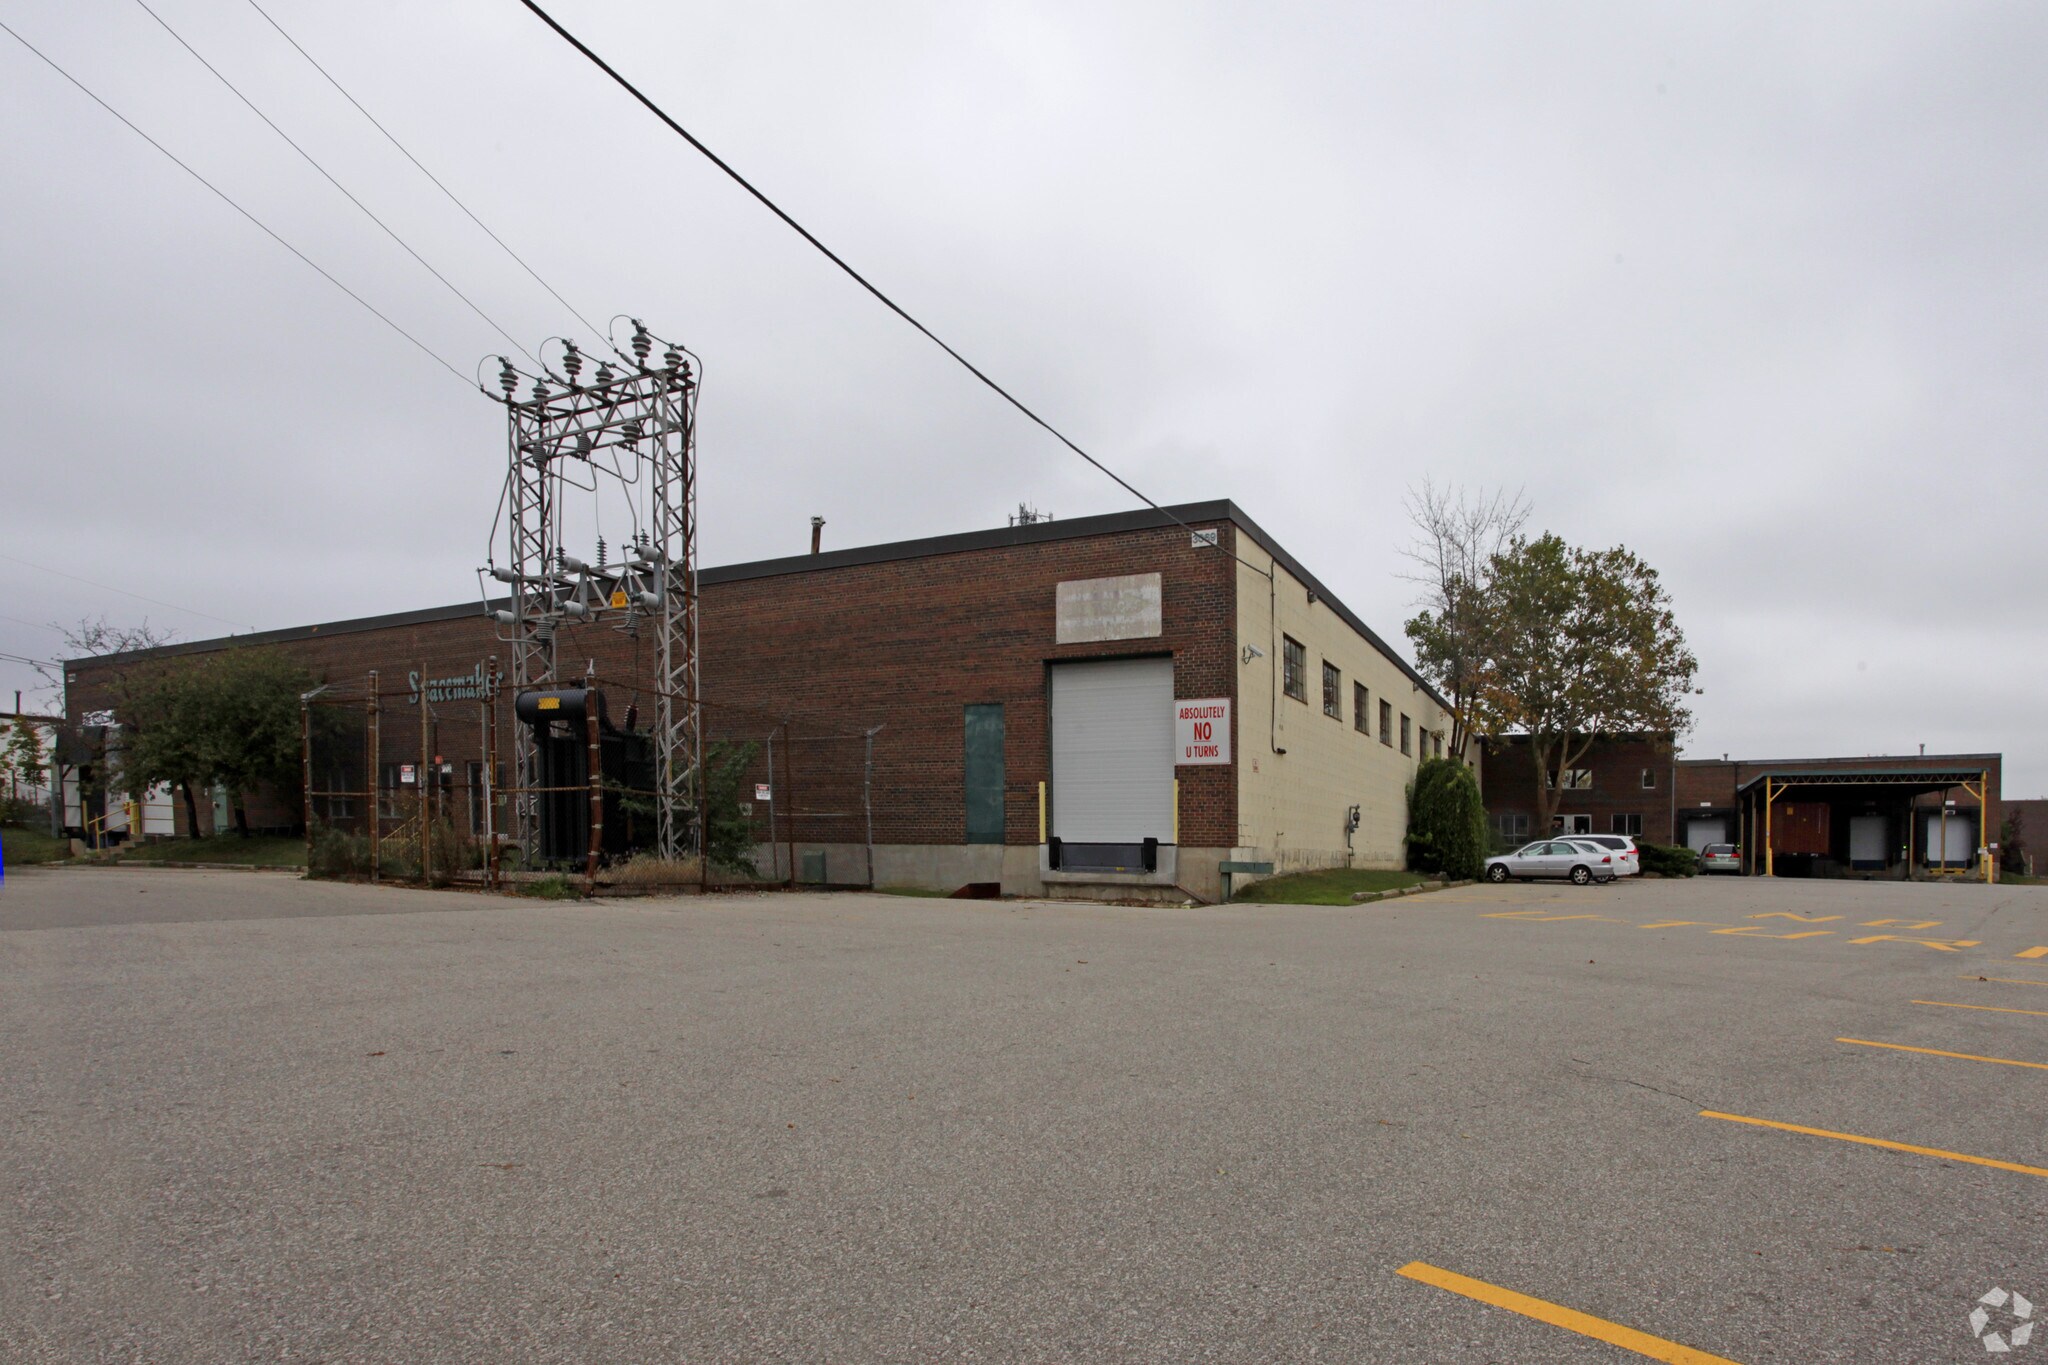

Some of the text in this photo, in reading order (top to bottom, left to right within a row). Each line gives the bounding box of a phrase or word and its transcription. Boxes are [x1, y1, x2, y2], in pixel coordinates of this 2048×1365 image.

[408, 663, 504, 705] Sacemaker
[1180, 706, 1225, 719] ABSOLUTELY
[1194, 722, 1212, 740] NO
[1186, 745, 1218, 758] U TURNS
[1746, 911, 1944, 930] NO
